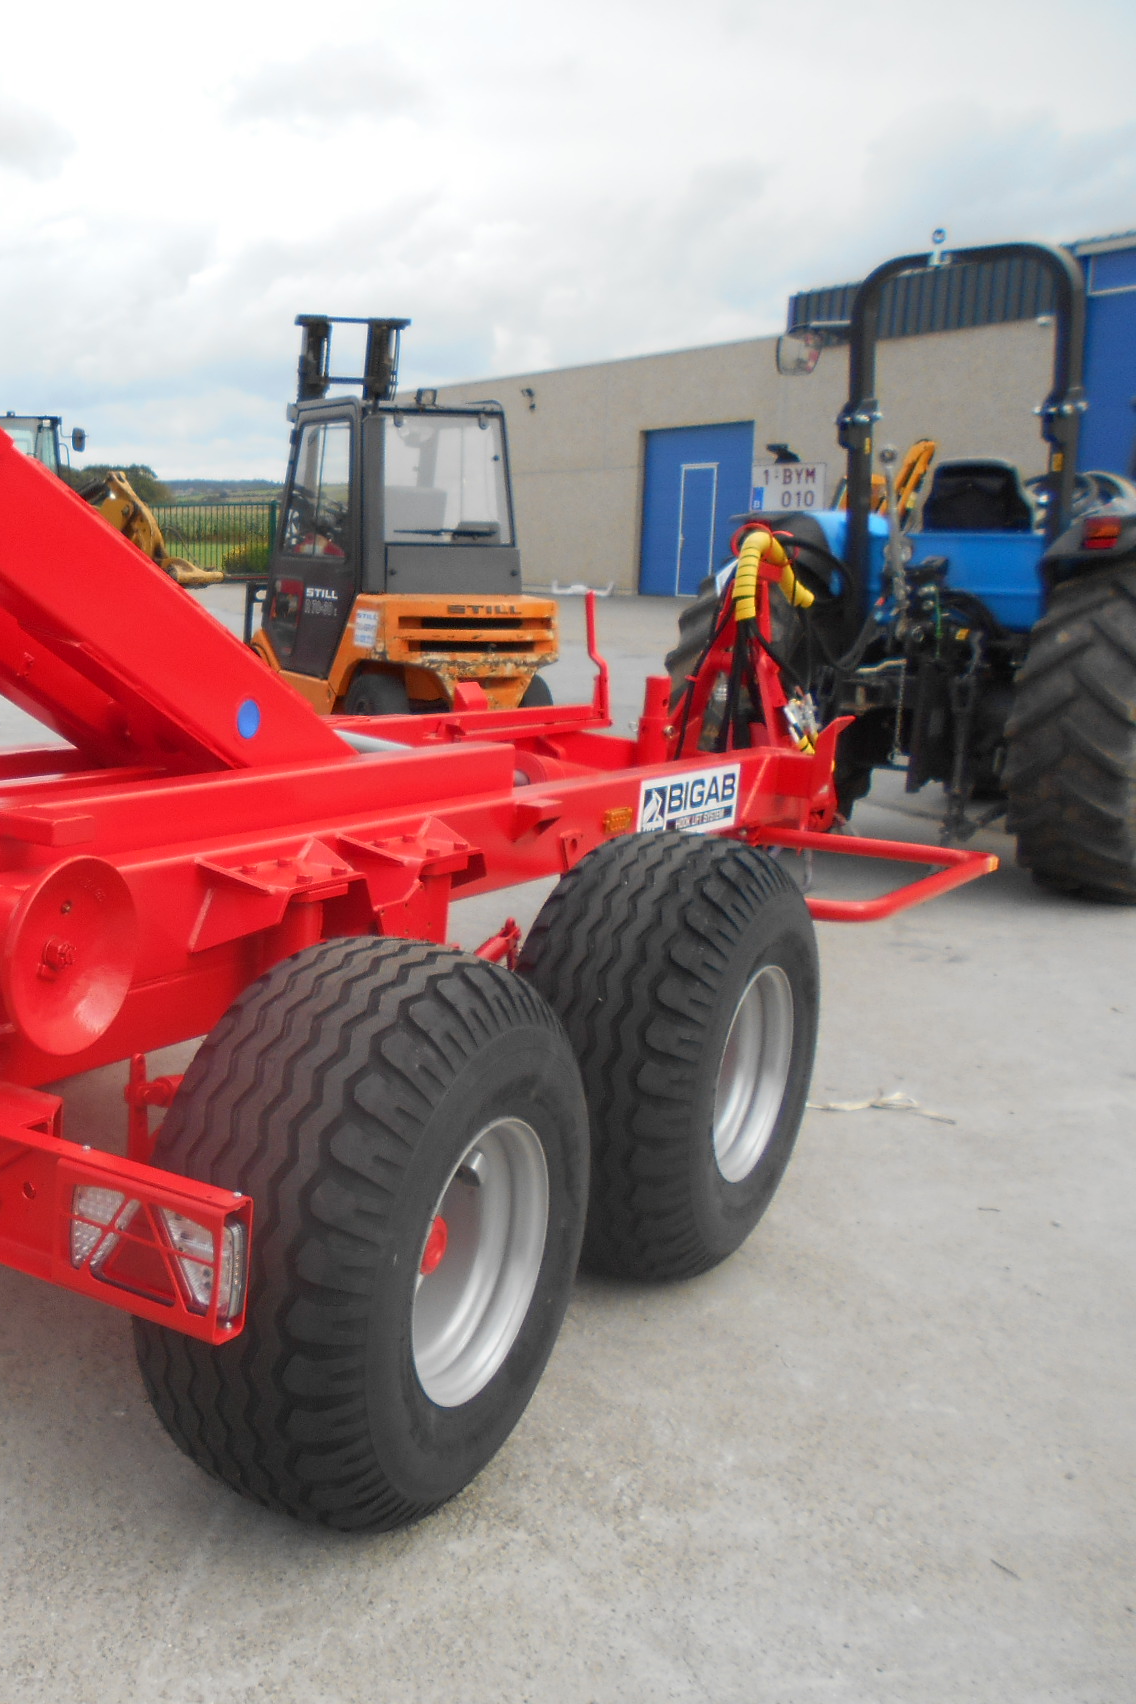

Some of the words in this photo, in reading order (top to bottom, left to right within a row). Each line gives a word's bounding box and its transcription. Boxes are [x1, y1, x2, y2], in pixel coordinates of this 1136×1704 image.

[781, 490, 814, 508] 010
[306, 587, 339, 600] STILL
[447, 604, 522, 615] STILL
[668, 772, 737, 814] BIGAB
